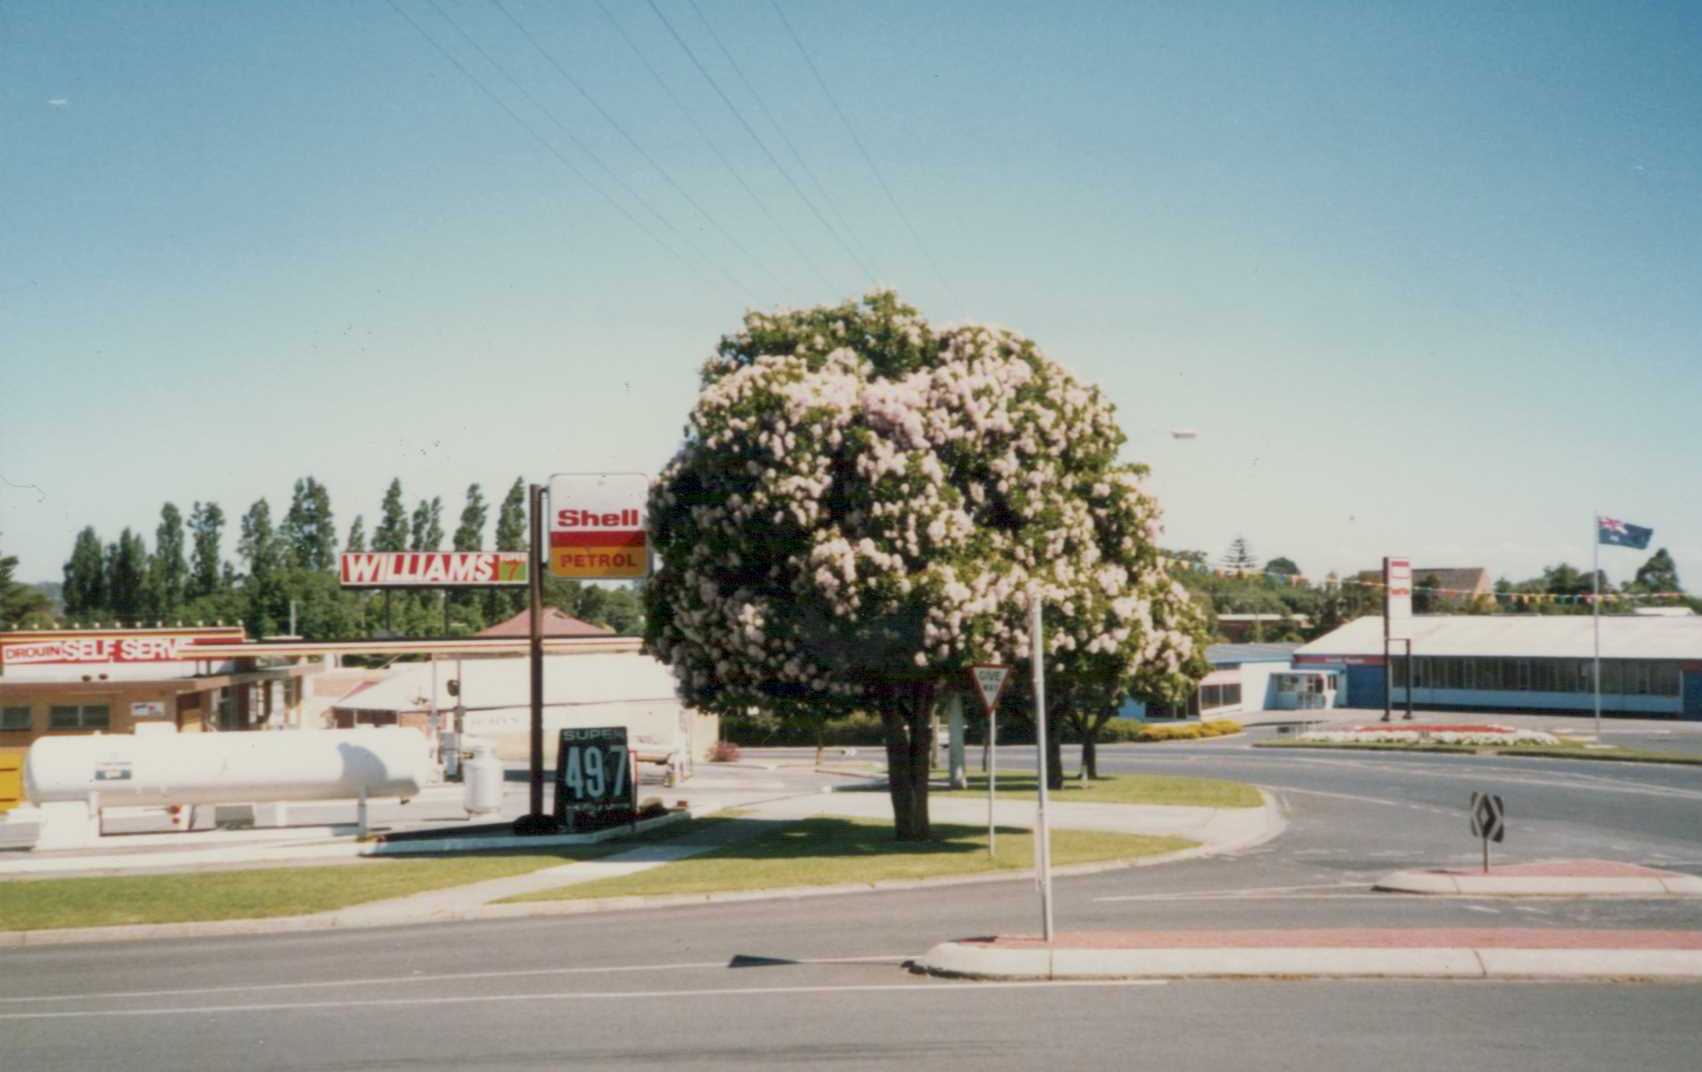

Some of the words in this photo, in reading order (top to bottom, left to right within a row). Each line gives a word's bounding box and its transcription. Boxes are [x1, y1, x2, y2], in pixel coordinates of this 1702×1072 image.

[558, 509, 639, 527] Shell
[345, 553, 496, 583] WILLIAMS
[561, 553, 638, 568] PETROL
[6, 646, 61, 660] DROUIN
[62, 639, 118, 662] SELF
[979, 670, 1001, 681] GIVE
